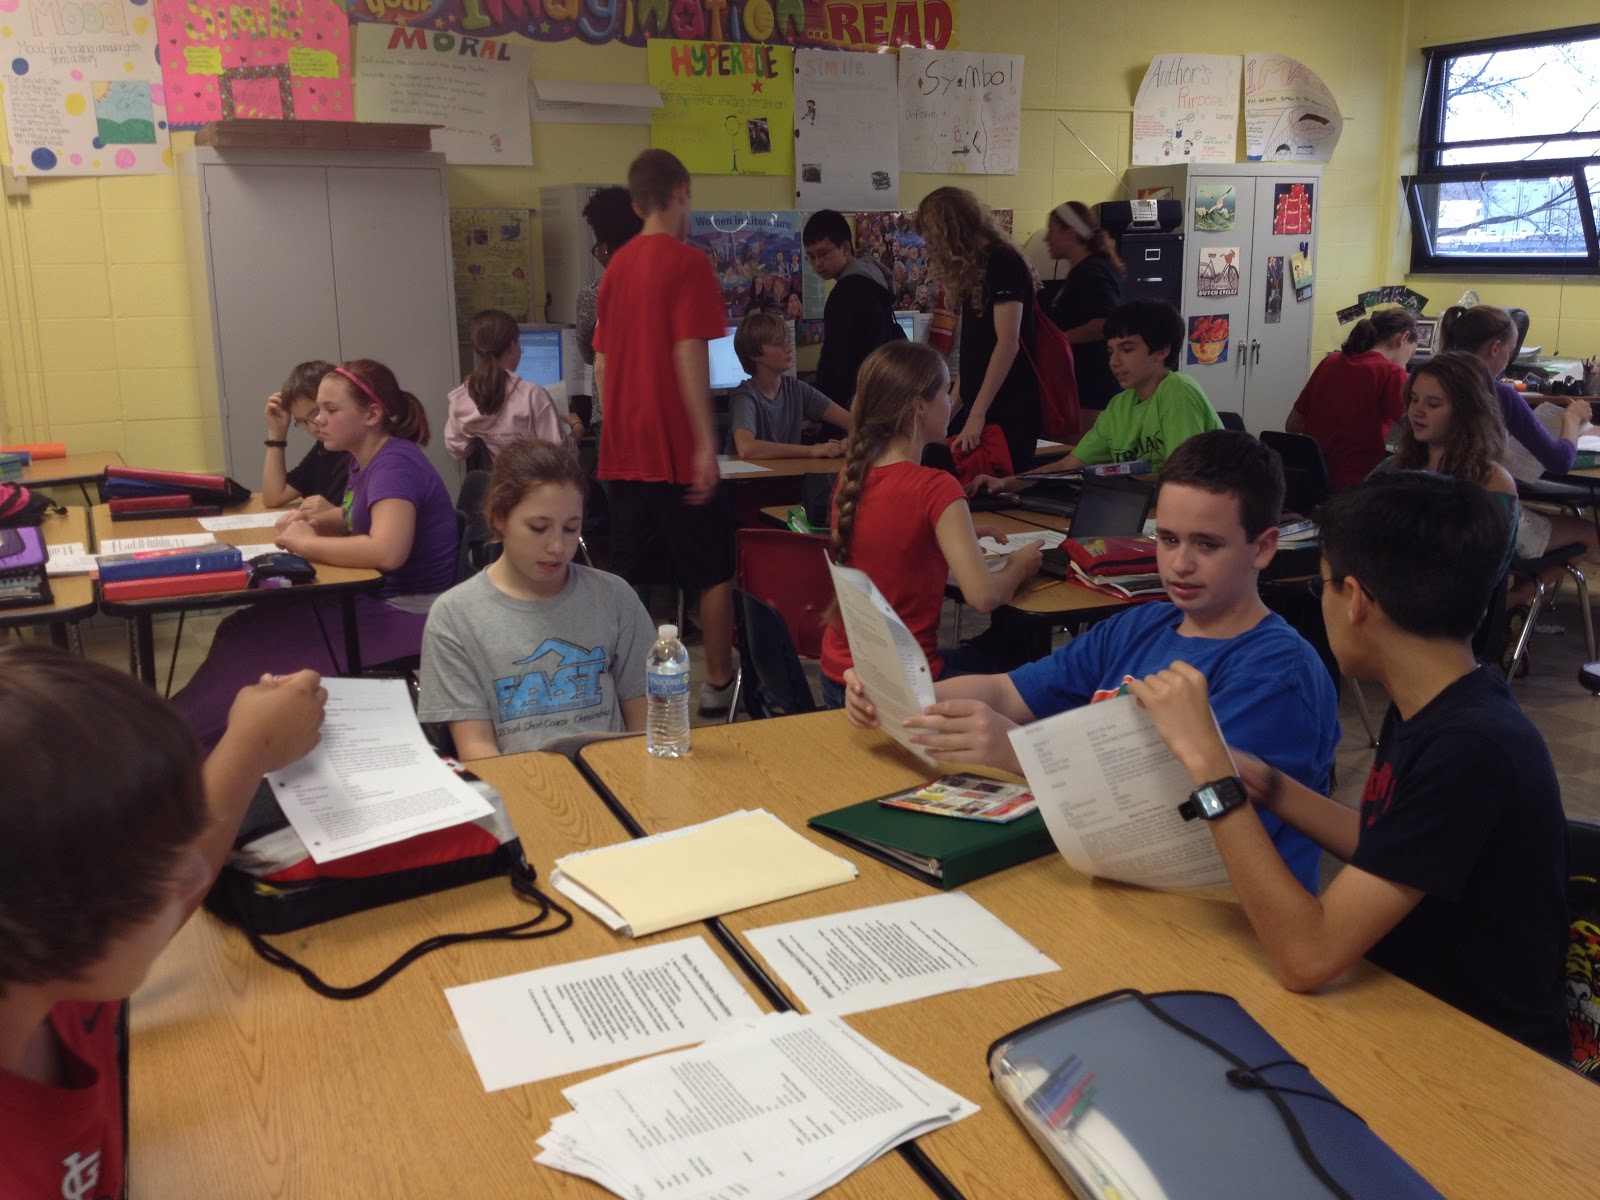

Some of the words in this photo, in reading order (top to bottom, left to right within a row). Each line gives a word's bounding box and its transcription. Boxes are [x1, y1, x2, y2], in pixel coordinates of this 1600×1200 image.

[387, 27, 511, 62] MORAL
[1147, 56, 1212, 90] Author's
[1177, 86, 1223, 110] Purpose
[695, 215, 733, 227] Women
[734, 215, 745, 227] in
[747, 215, 792, 230] Literature
